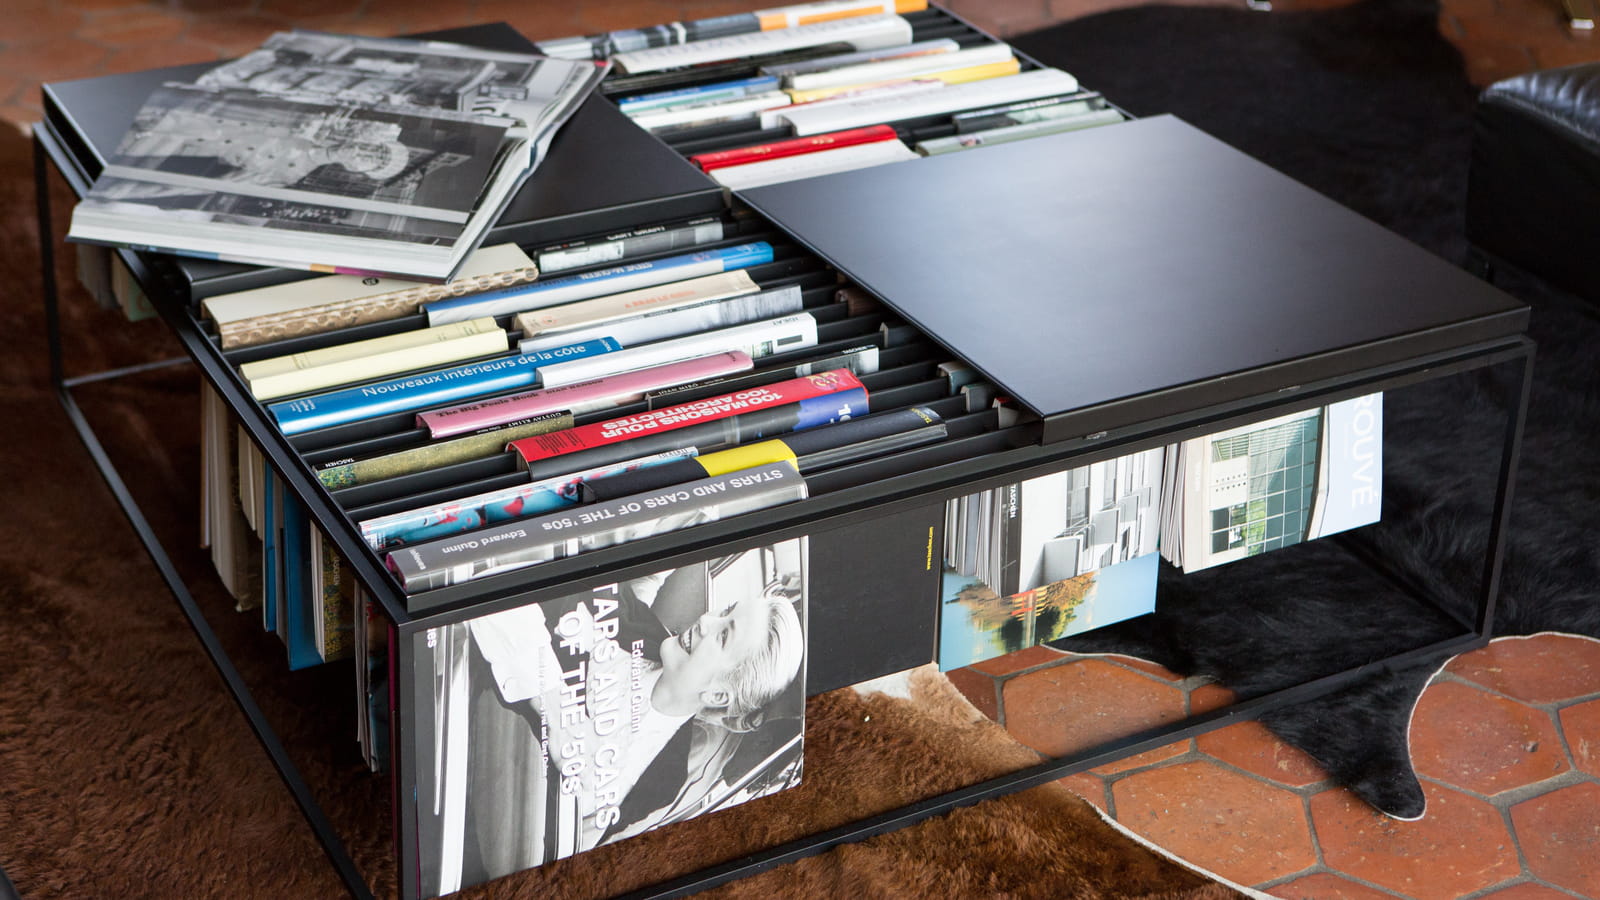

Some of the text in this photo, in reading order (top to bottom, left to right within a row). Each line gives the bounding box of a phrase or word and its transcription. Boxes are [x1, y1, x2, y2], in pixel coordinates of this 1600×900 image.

[362, 375, 442, 397] Nouveaux
[443, 358, 516, 381] intérieurs
[518, 353, 537, 367] de
[539, 350, 552, 362] la
[554, 343, 587, 358] côte
[436, 408, 459, 419] The
[460, 404, 480, 414] Big
[512, 391, 541, 403] Book
[601, 392, 783, 439] 100 MAISONS POUR
[602, 388, 770, 431] 100 ARCHITECTES
[531, 411, 562, 424] GUSTAV
[325, 458, 355, 468] TASCHEN
[691, 479, 727, 497] AND
[735, 468, 784, 486] STARS
[619, 501, 646, 516] OF
[647, 489, 691, 509] CARS
[582, 508, 616, 525] THE
[442, 541, 479, 555] Quinn
[485, 528, 527, 545] Edward
[559, 609, 586, 656] OF
[560, 660, 586, 729] THE
[631, 639, 645, 735] Edward Quinn
[593, 673, 619, 737] AND
[593, 745, 621, 831] CARS
